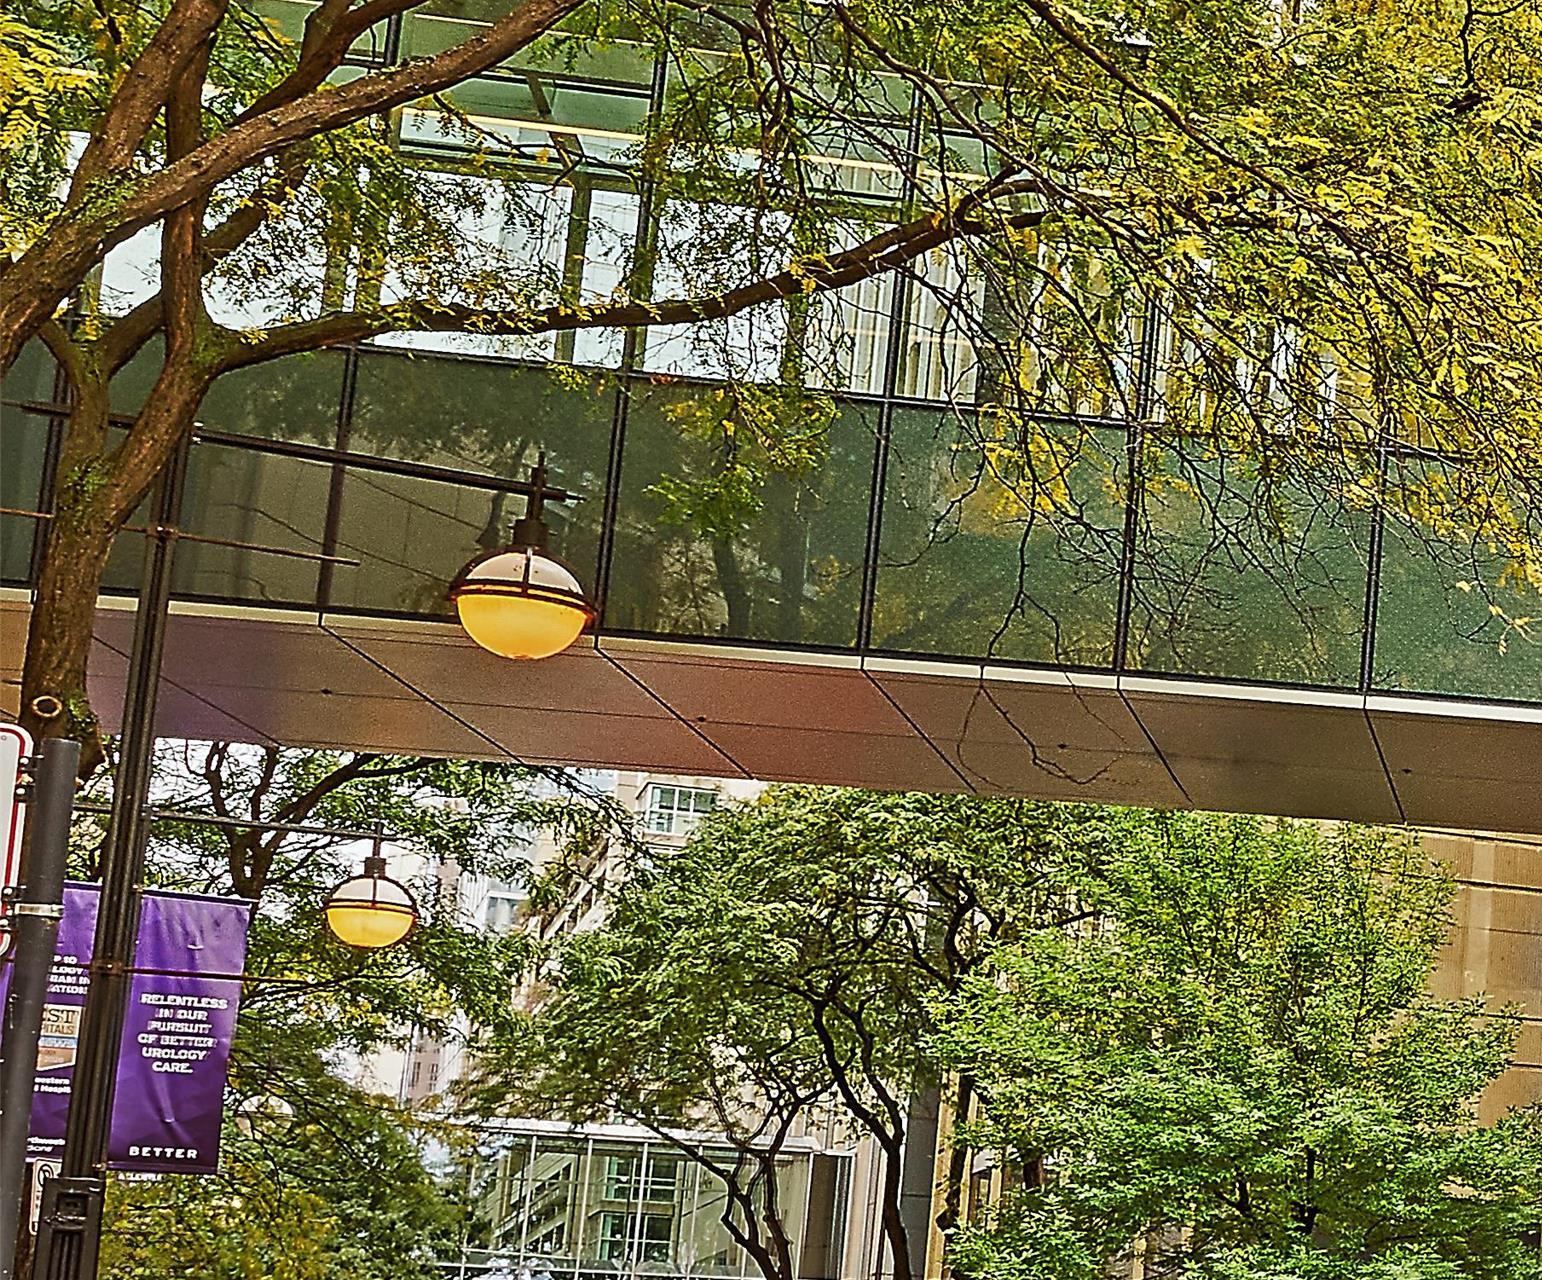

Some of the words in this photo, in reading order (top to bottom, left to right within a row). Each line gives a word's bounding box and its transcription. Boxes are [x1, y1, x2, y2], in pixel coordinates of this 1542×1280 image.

[140, 993, 228, 1009] RELENTLESS
[176, 1009, 208, 1020] OUR
[141, 1046, 207, 1060] UROLOGY
[151, 1061, 193, 1074] CARE.
[129, 1146, 198, 1159] BETTER
